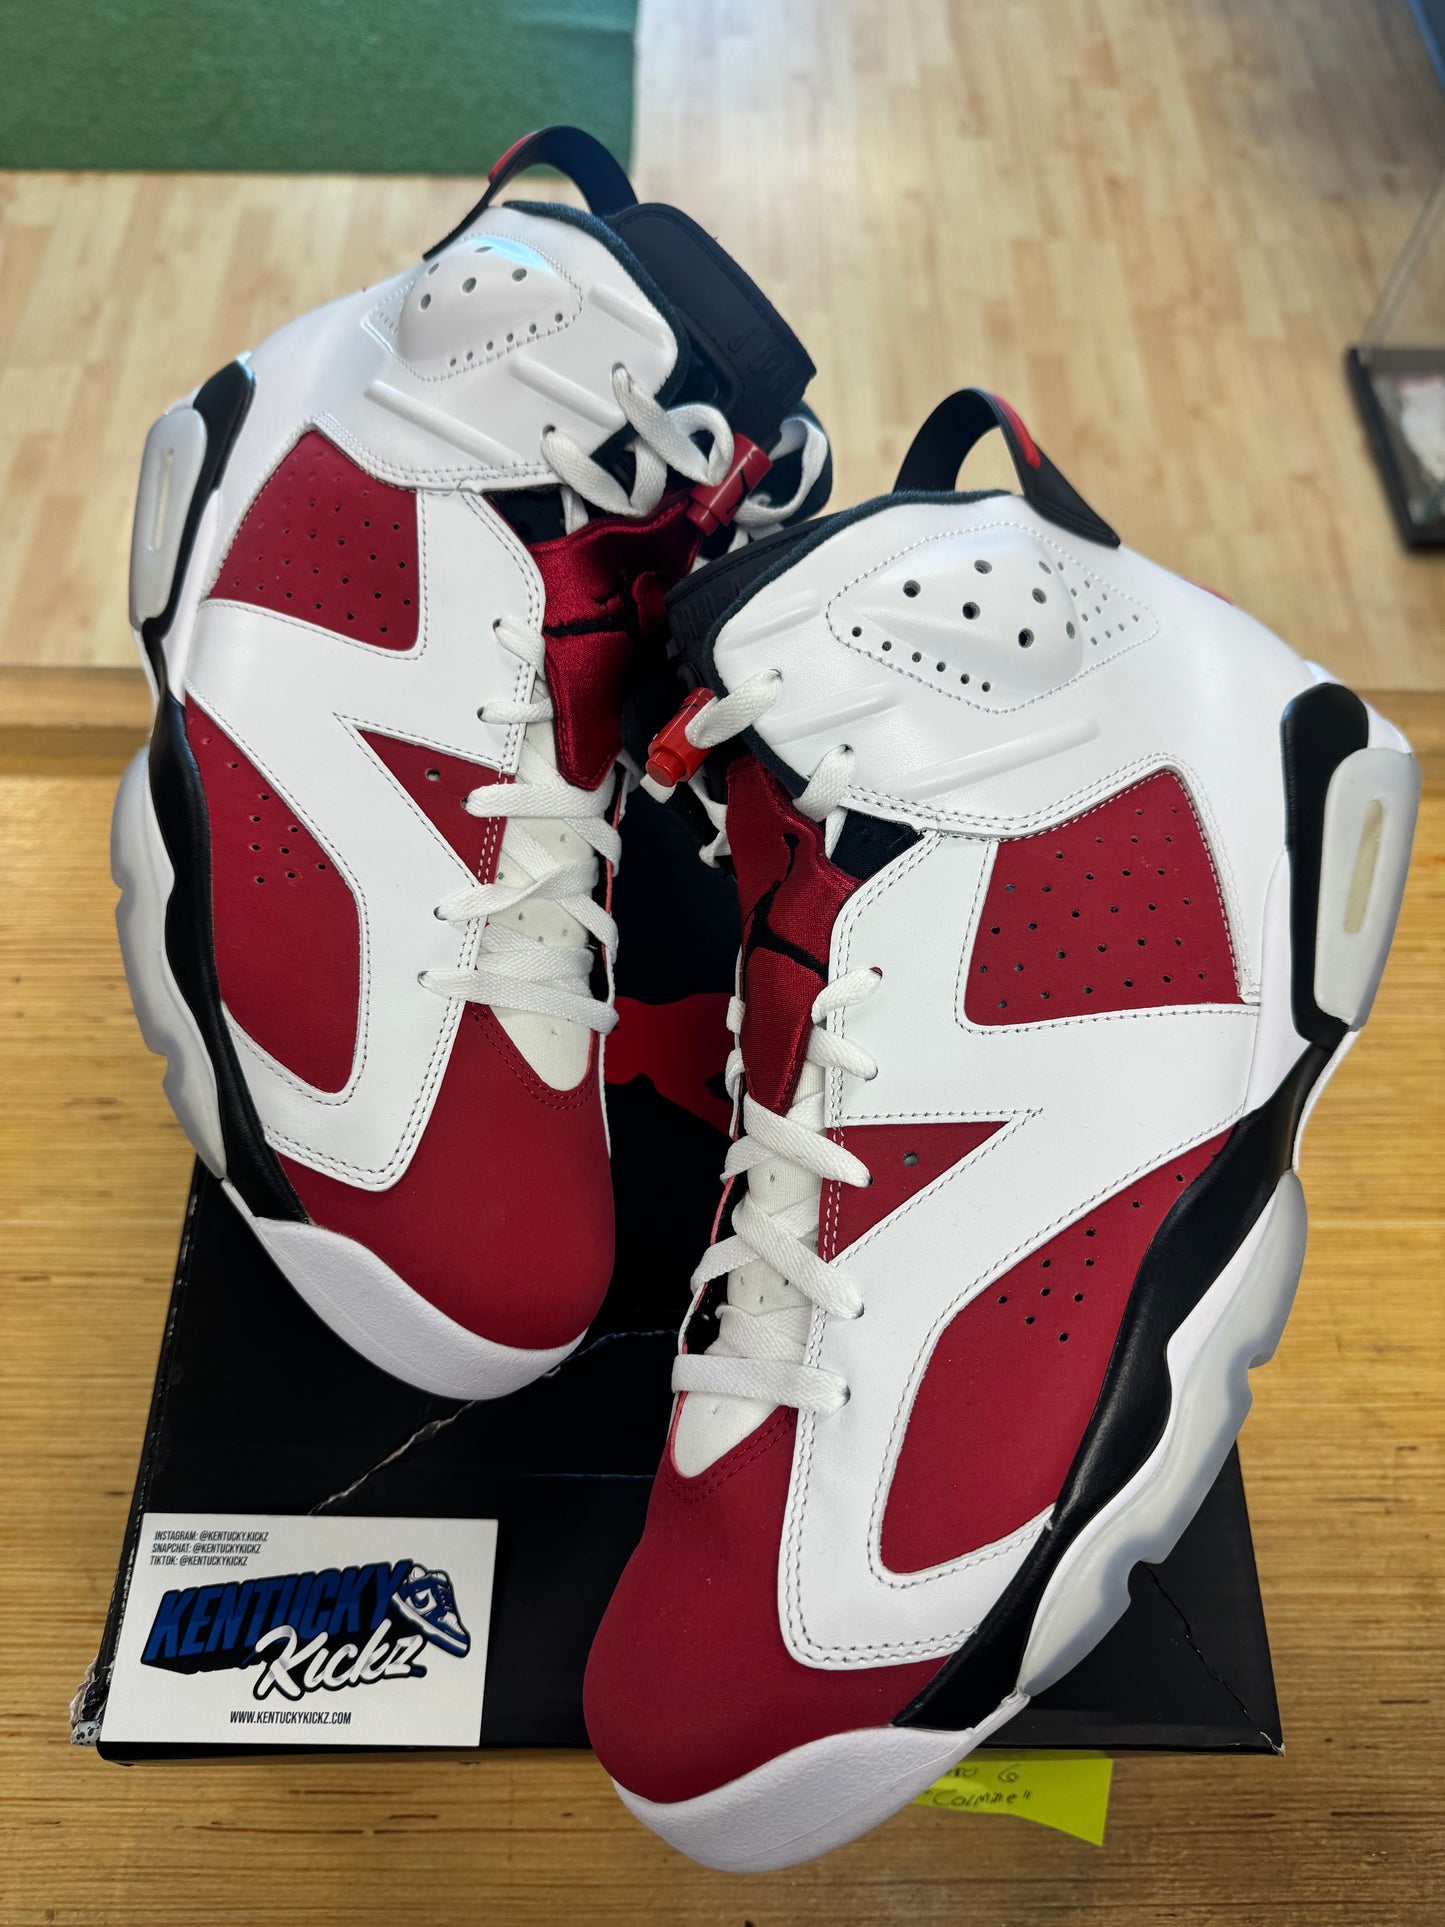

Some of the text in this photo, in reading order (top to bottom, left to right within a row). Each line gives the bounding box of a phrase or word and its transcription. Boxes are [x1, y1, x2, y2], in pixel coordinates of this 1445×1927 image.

[154, 1530, 269, 1542] INSTAGRAM: @KENTUCKY.KICKZ
[152, 1543, 261, 1554] SNAPCHAT: @KENTUCKYKICKZ
[150, 1555, 248, 1566] TIKTOK: @KENTUCKYKICKZ
[142, 1559, 413, 1664] KENTUCKY
[254, 1618, 424, 1698] Kickz
[229, 1710, 352, 1725] WWW.KENTUCKYKICKZ.COM
[996, 1763, 1021, 1782] 6
